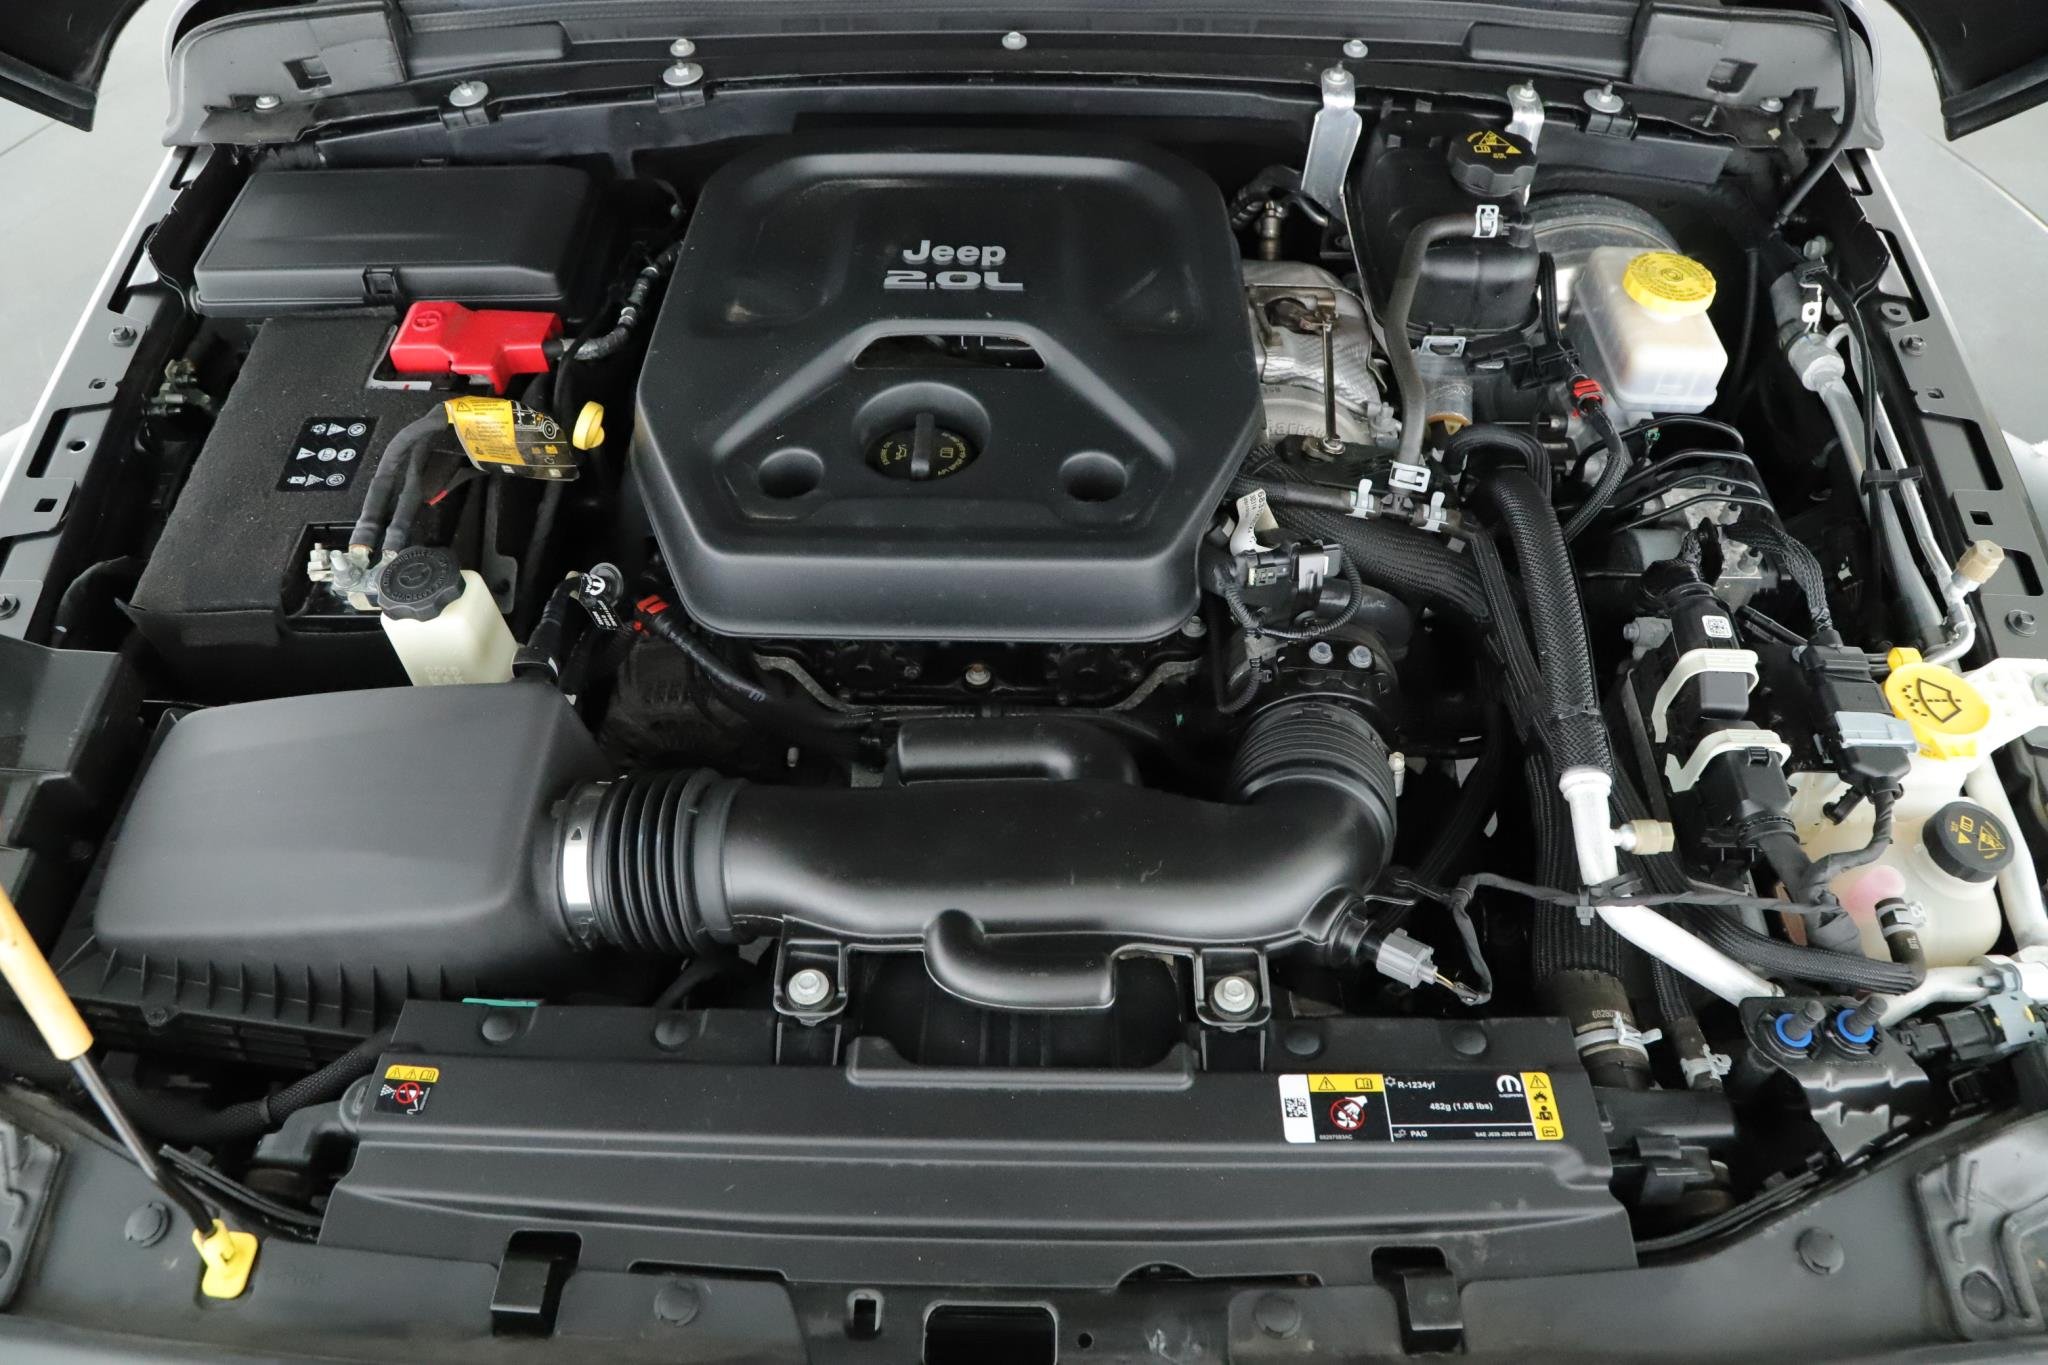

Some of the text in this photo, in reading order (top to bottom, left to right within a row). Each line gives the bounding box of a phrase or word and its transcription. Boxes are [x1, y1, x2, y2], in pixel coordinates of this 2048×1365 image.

[902, 239, 1006, 267] Jeep
[883, 269, 1024, 291] 2.0L
[1429, 1102, 1451, 1111] 482g
[1476, 1102, 1494, 1111] lbs)
[1410, 1130, 1428, 1138] PAG
